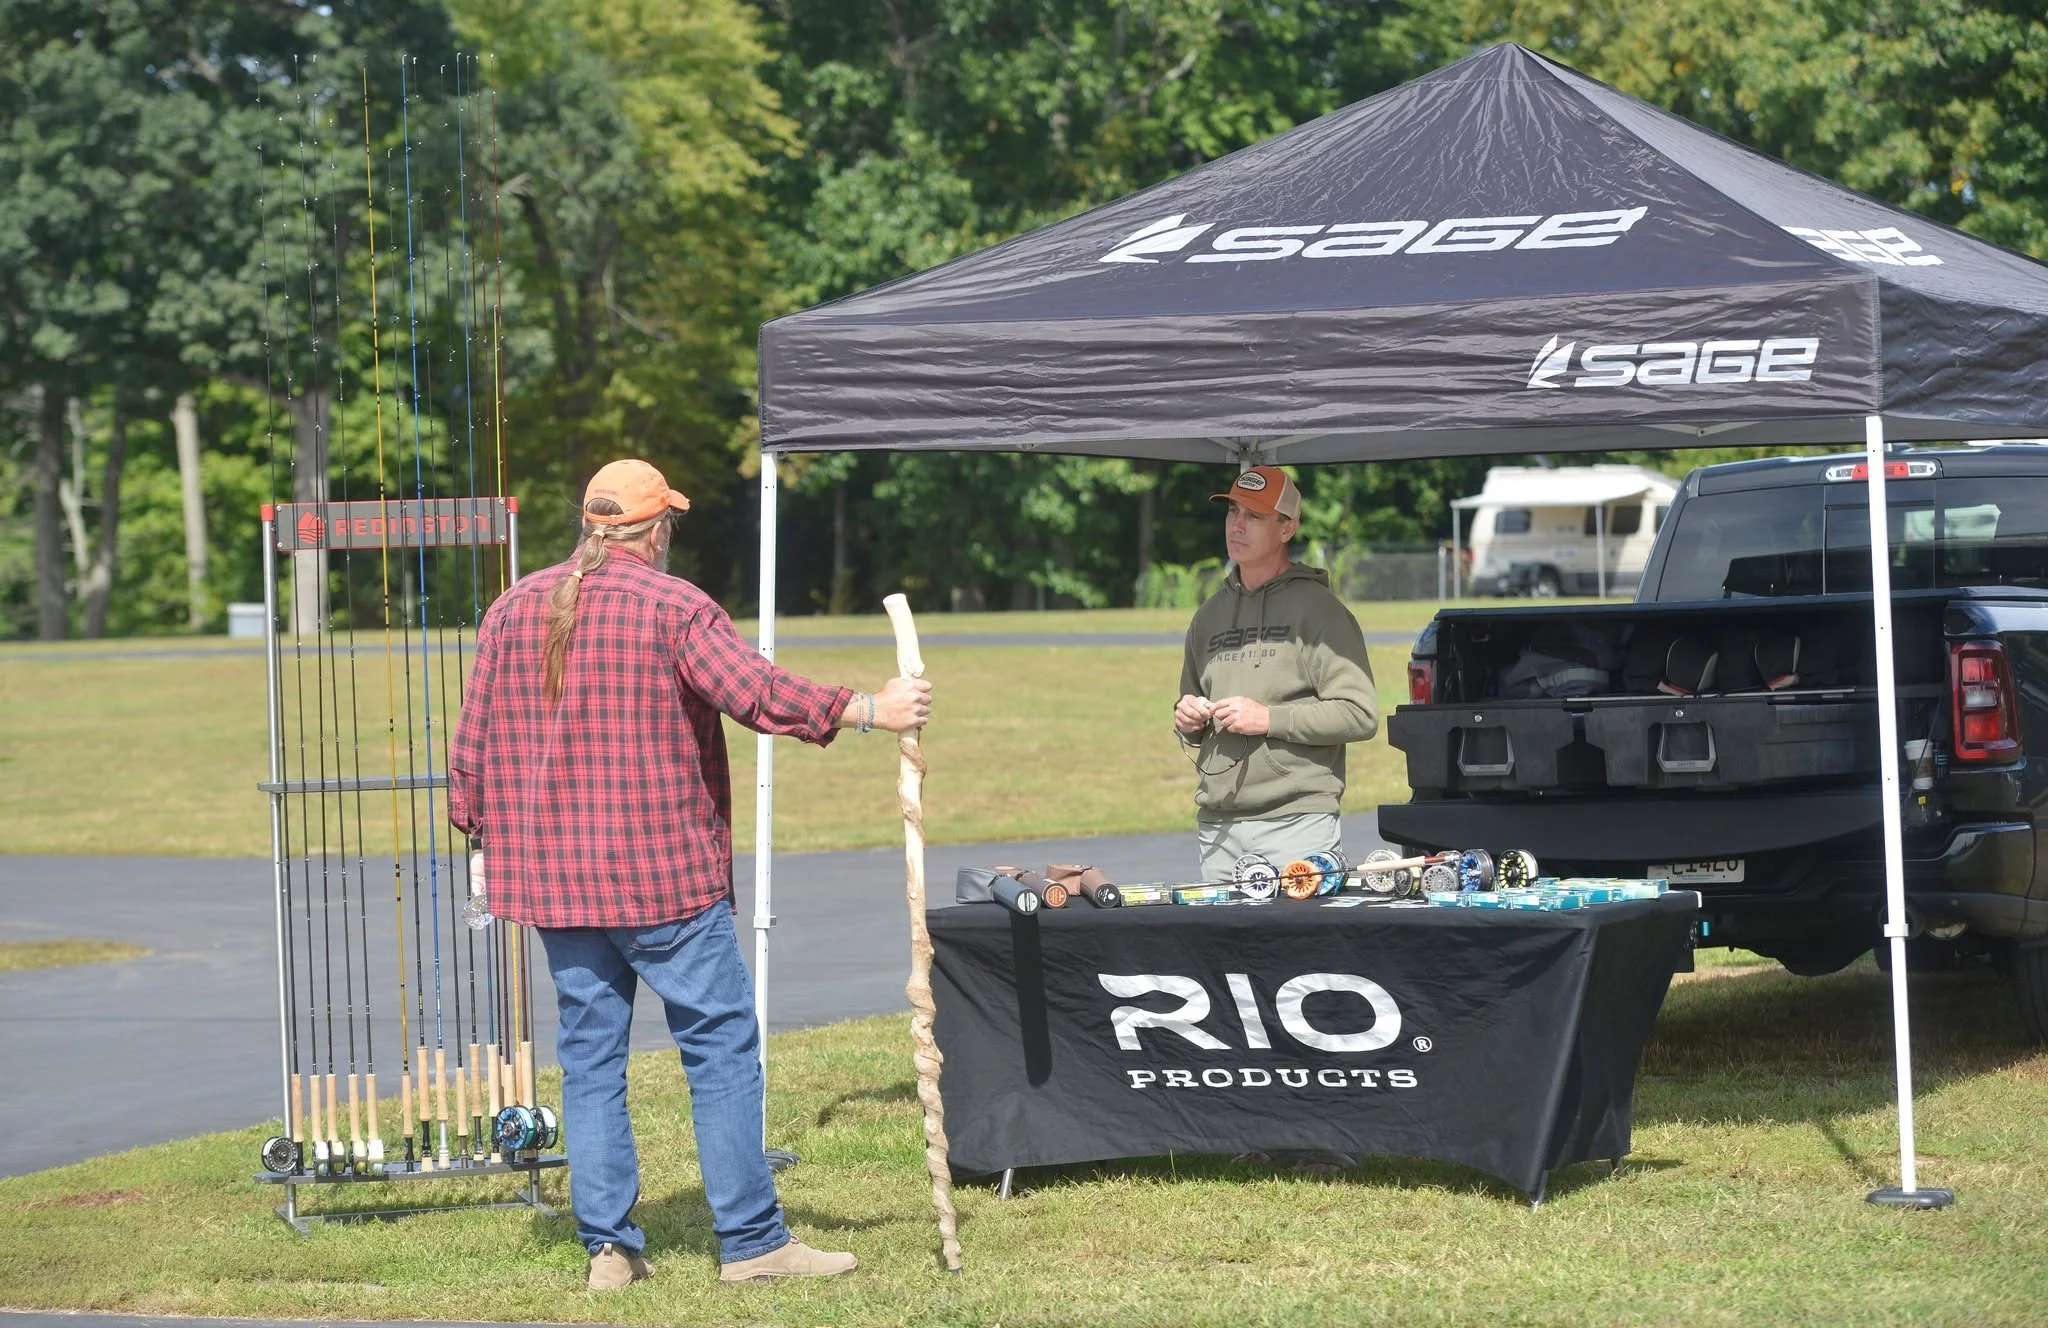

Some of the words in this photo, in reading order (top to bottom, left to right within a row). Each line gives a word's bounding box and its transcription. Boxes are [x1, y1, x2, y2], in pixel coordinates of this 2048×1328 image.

[1780, 227, 1944, 266] age
[1097, 972, 1402, 1053] RIO
[1126, 1067, 1418, 1089] PRODUCTS
